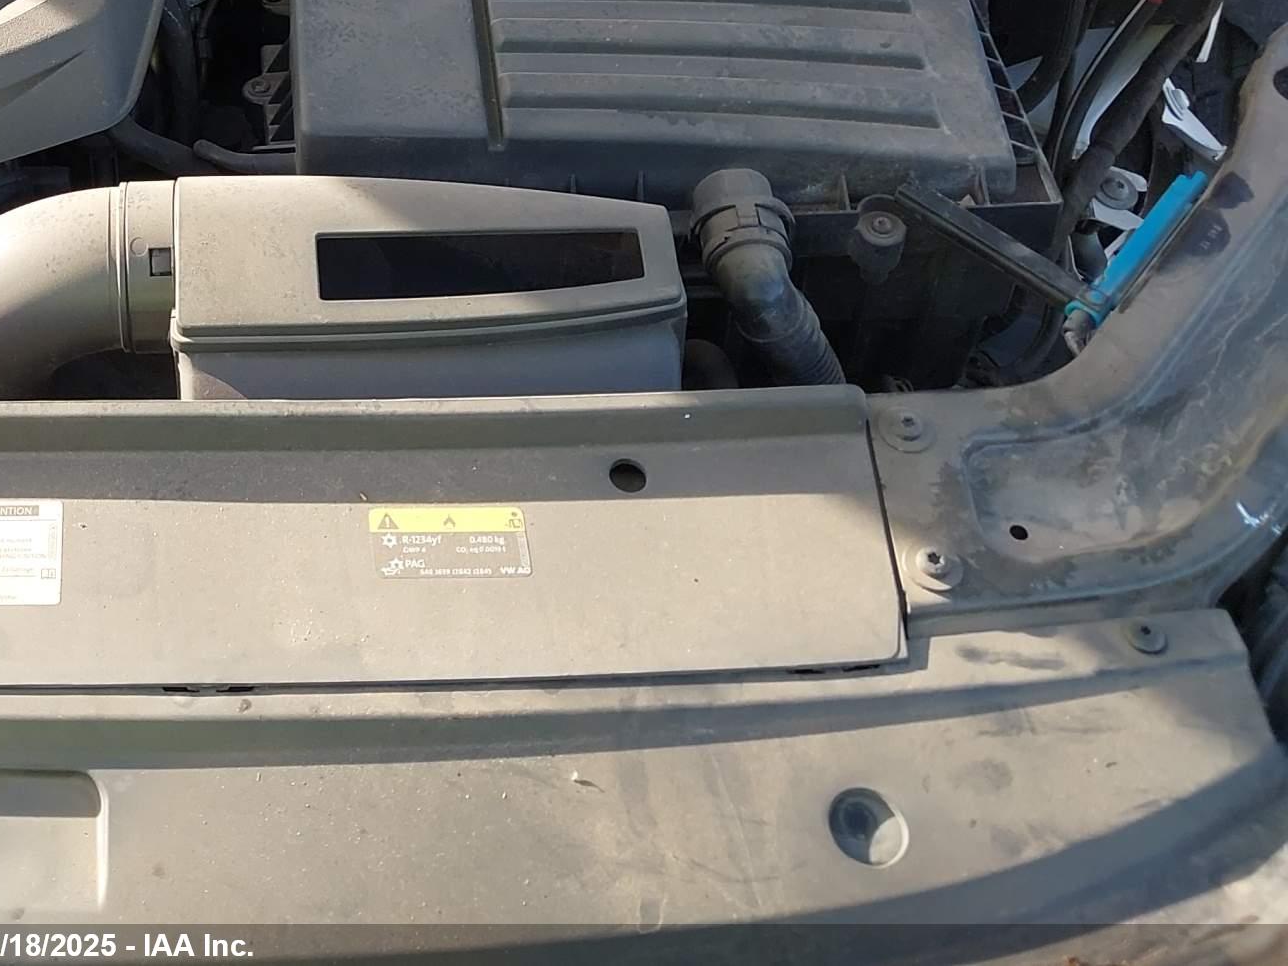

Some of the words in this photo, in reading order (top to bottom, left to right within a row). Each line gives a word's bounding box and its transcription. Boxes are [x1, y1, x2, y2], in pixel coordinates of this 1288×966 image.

[402, 535, 442, 546] R-1234yf
[495, 535, 505, 545] kg
[405, 559, 426, 568] PAG
[499, 567, 515, 575] VW
